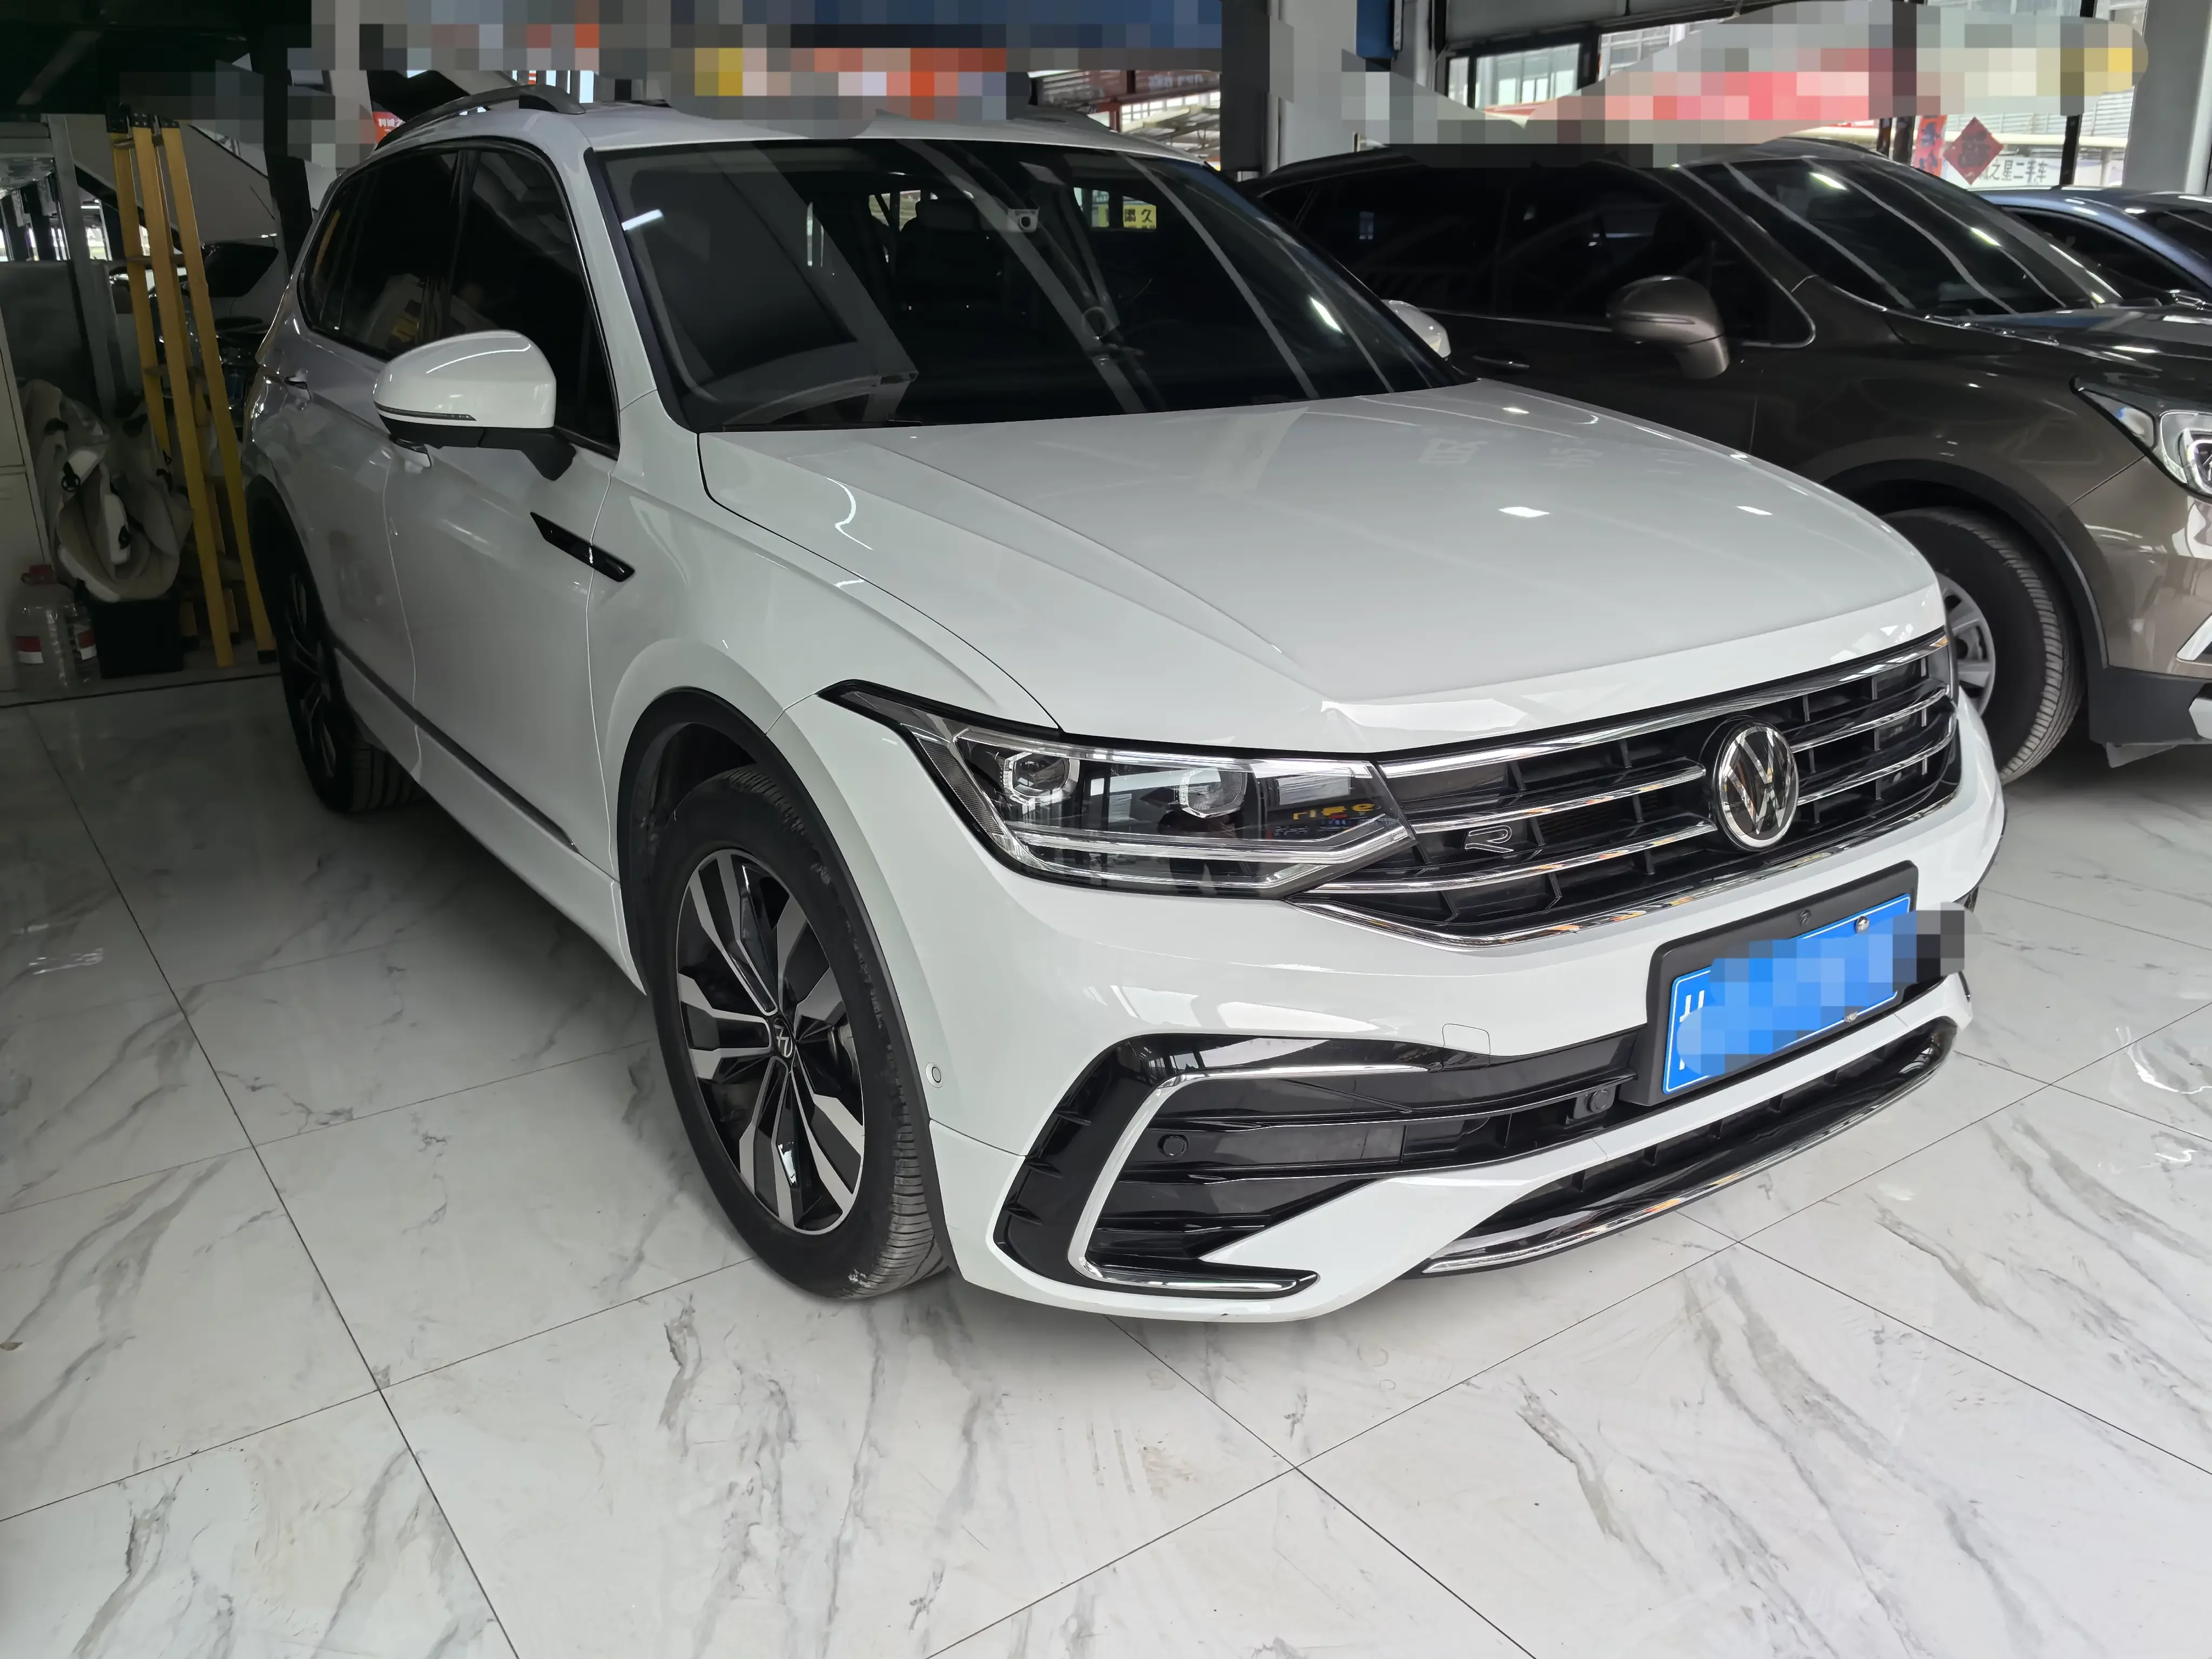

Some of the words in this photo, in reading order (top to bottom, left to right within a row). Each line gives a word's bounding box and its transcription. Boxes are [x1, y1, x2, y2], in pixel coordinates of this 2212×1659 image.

[1979, 158, 2048, 184] 之星二手车
[1465, 825, 1514, 853] R
